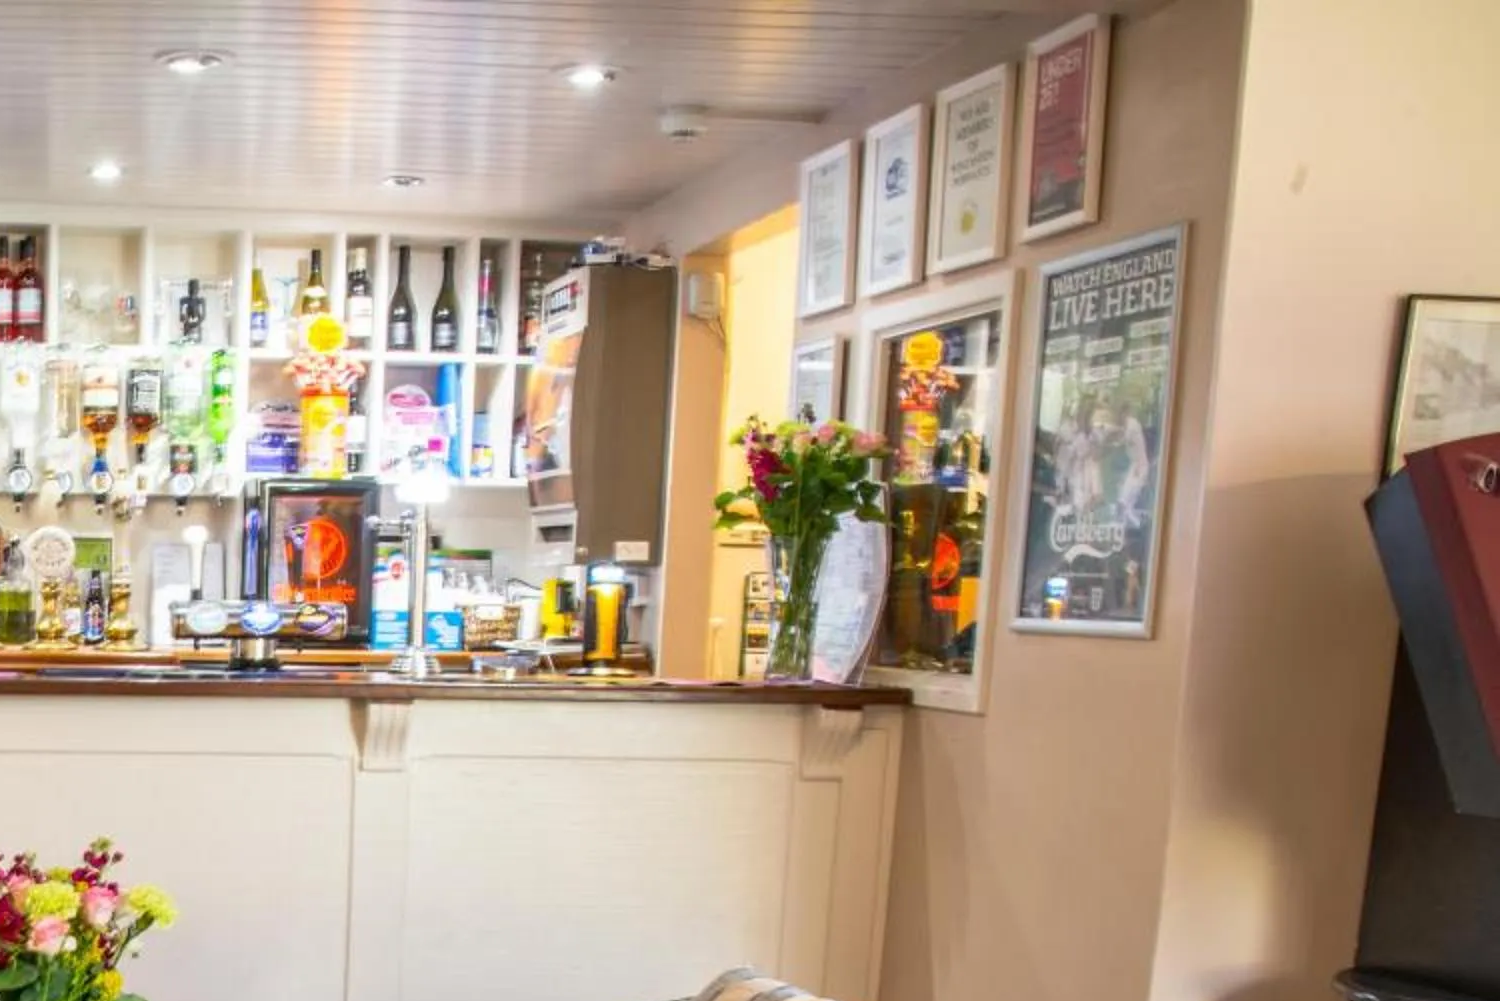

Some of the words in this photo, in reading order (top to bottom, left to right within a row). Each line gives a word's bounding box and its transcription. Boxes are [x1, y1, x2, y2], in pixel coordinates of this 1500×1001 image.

[1050, 289, 1100, 331] LIVE
[1102, 272, 1174, 319] HERE
[1052, 267, 1101, 299] WATCH
[1102, 248, 1174, 284] ENGLAND
[1048, 503, 1126, 559] Carlsberg
